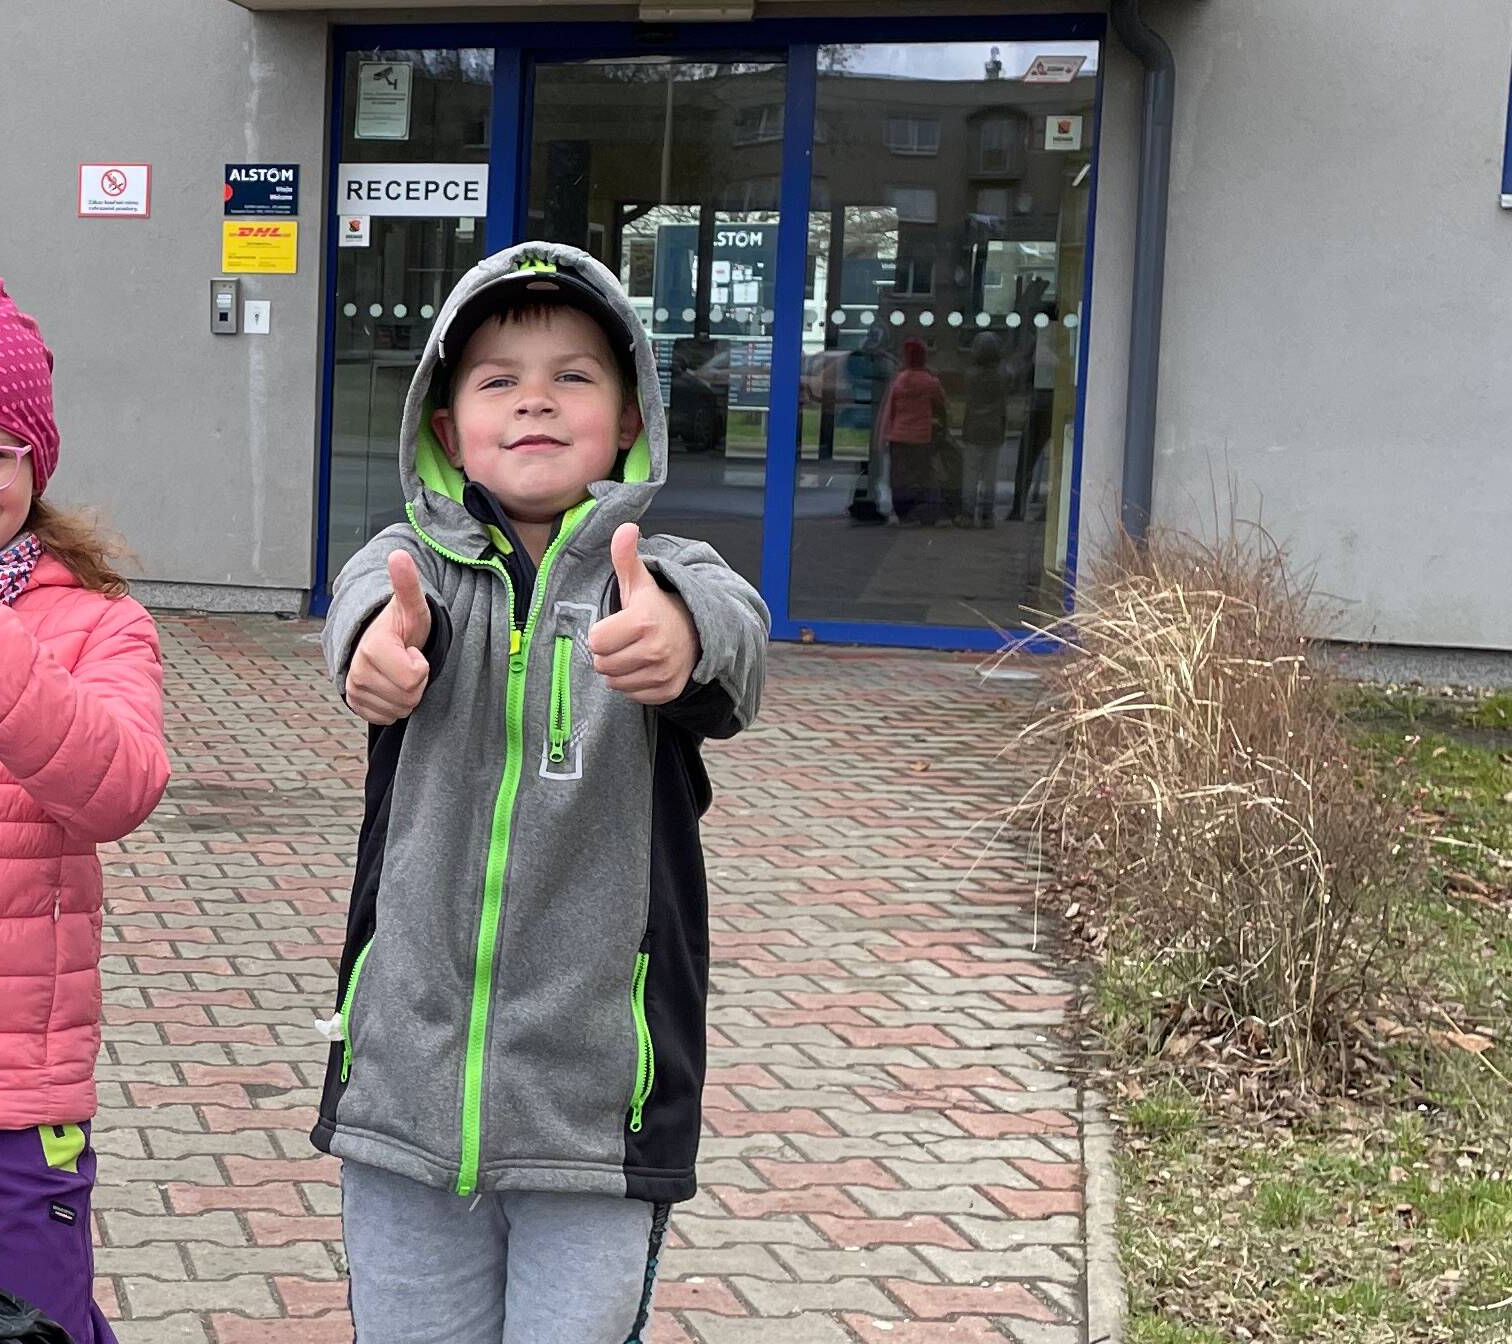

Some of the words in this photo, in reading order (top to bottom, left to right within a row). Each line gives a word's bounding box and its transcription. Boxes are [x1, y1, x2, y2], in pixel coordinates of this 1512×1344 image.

[229, 167, 294, 183] ALSTOM
[346, 180, 479, 201] RECEPCE
[238, 227, 281, 237] DHL
[713, 230, 763, 248] STOM
